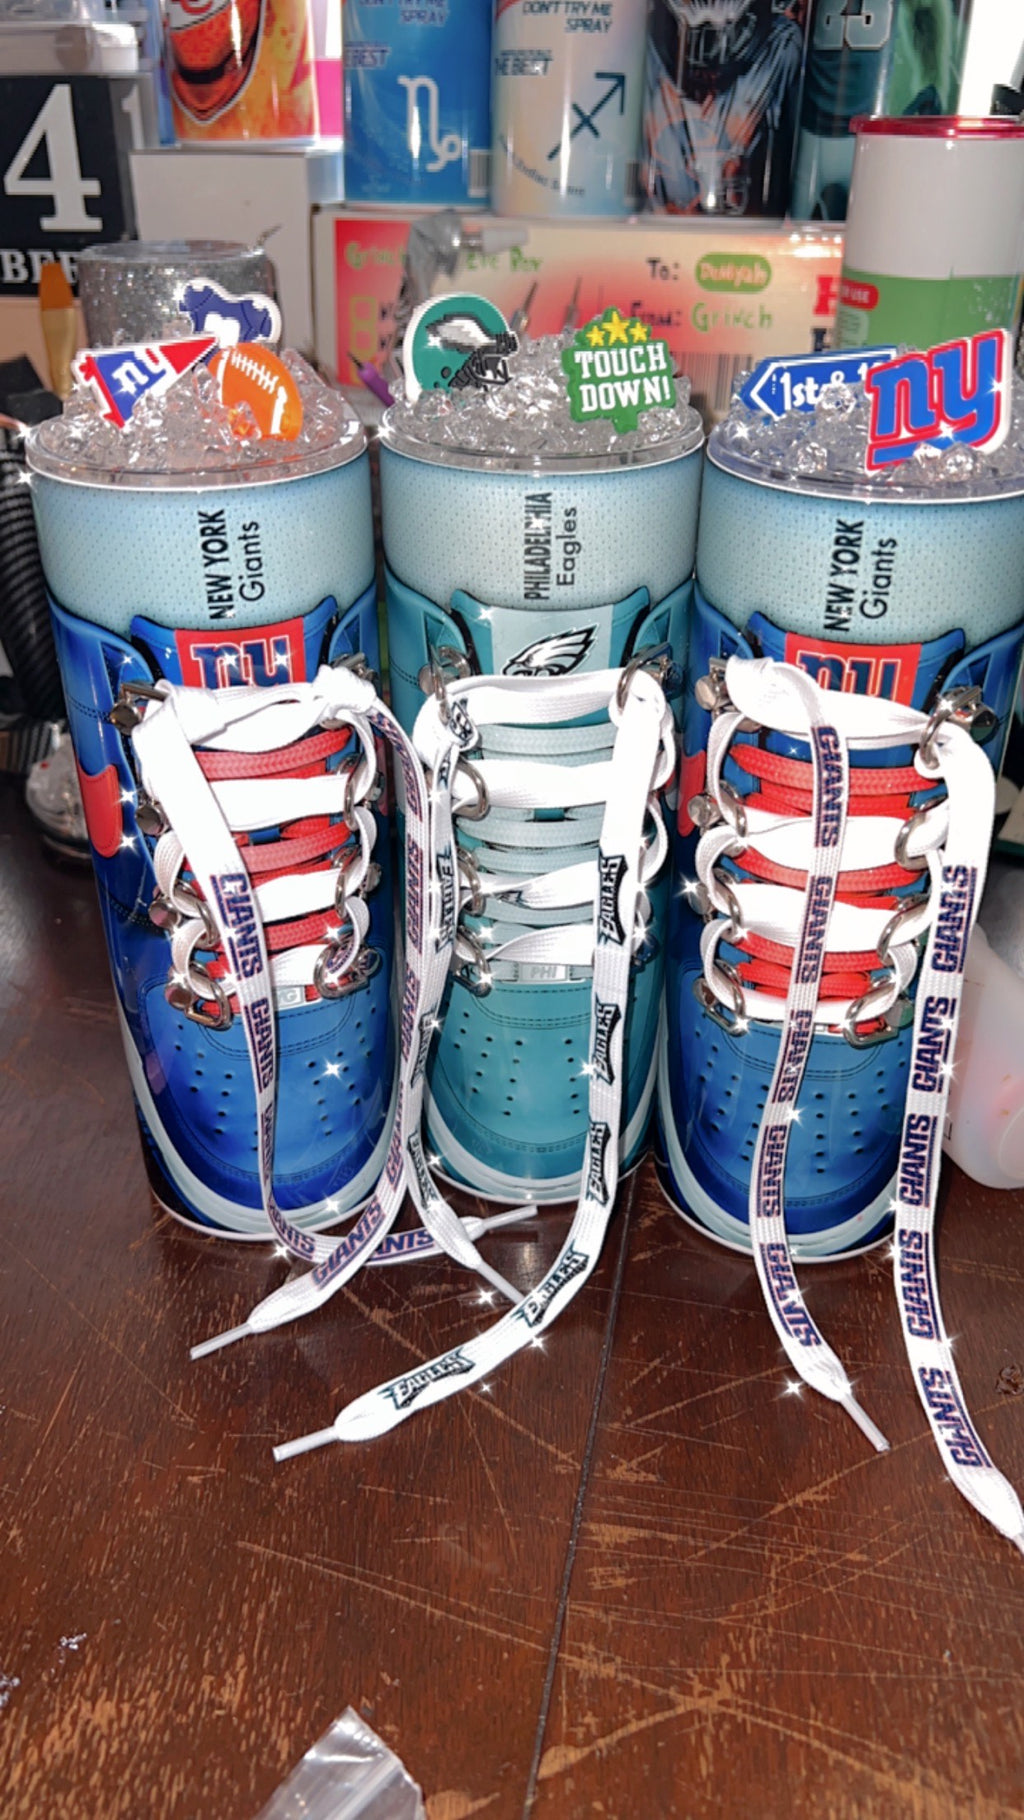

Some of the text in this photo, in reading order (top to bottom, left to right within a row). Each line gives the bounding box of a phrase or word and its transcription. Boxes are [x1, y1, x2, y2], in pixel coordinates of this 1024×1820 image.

[565, 18, 613, 33] SPRAY
[3, 84, 103, 232] 4
[574, 342, 667, 379] TOUCH
[579, 375, 671, 413] DOWN!
[198, 509, 234, 621] NEW YORK
[238, 521, 265, 602] Giants
[555, 506, 582, 587] Eagles
[823, 518, 864, 632] NEW YORK
[859, 537, 898, 619] Giants
[816, 726, 844, 847] GIANTS
[219, 872, 263, 979] GIANTS
[599, 852, 628, 946] EAGLES
[801, 876, 833, 984] GIANTS
[931, 865, 968, 973] GIANTS
[251, 997, 274, 1089] GIANTS
[591, 993, 621, 1086] EAGLES
[912, 996, 950, 1092] GIANTS
[586, 1115, 611, 1208] EAGLES
[762, 1125, 787, 1218] GIANTS
[900, 1114, 931, 1207] GIANTS
[311, 1195, 385, 1286] GIANTS
[899, 1229, 934, 1341] GIANTS
[377, 1348, 476, 1411] EAGLES
